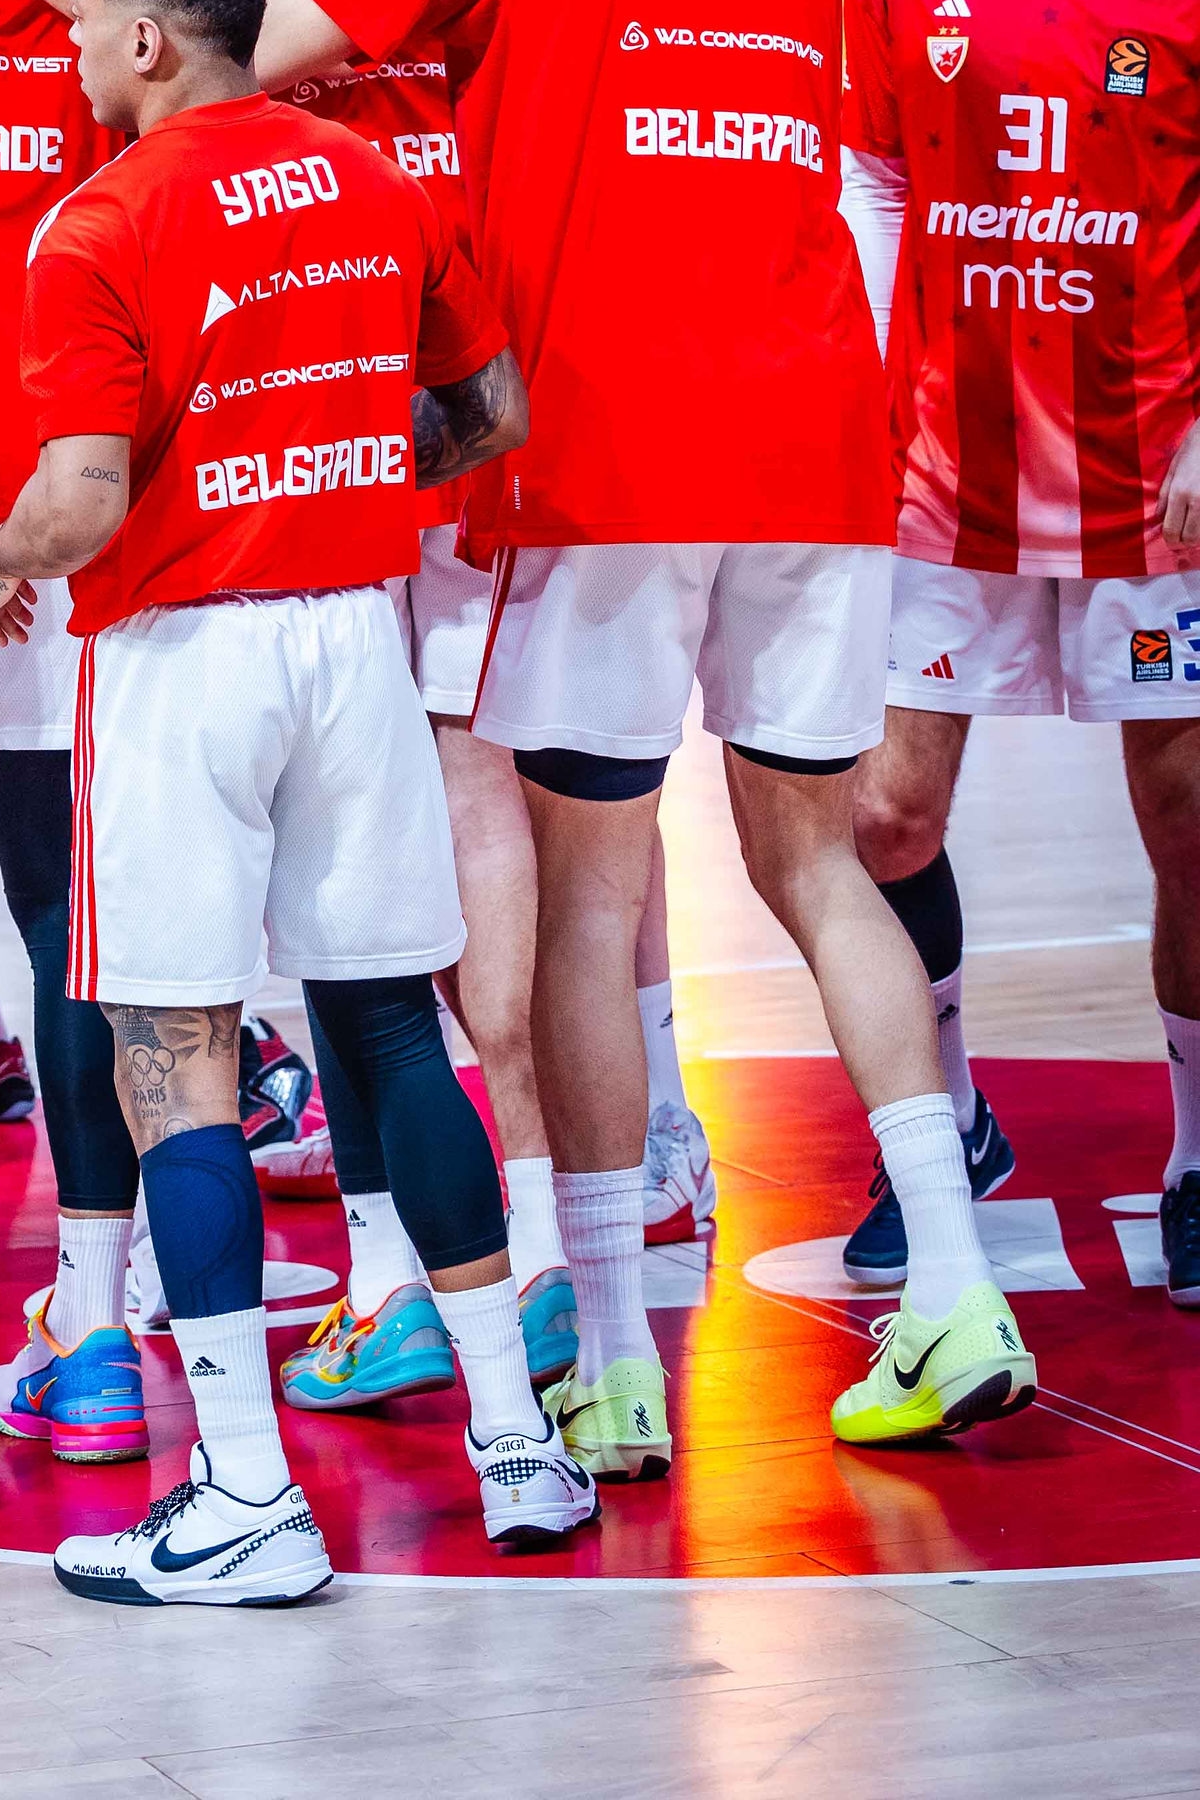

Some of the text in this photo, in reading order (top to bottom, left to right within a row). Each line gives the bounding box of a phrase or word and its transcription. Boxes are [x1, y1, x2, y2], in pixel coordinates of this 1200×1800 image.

[654, 28, 697, 46] W.D.
[700, 30, 795, 54] CONCORD
[12, 57, 72, 73] WEST
[624, 108, 823, 174] BELGRADE
[997, 94, 1068, 173] 31
[211, 154, 340, 227] YAGO
[926, 195, 1139, 245] meridian
[963, 257, 1095, 314] mts
[220, 353, 410, 400] W.D. CONCORD WEST
[195, 434, 408, 511] BELGRADE
[1135, 662, 1169, 670] TURKISH
[133, 1086, 166, 1107] PARIS
[190, 1368, 226, 1377] adidas
[496, 1439, 526, 1453] GIGI
